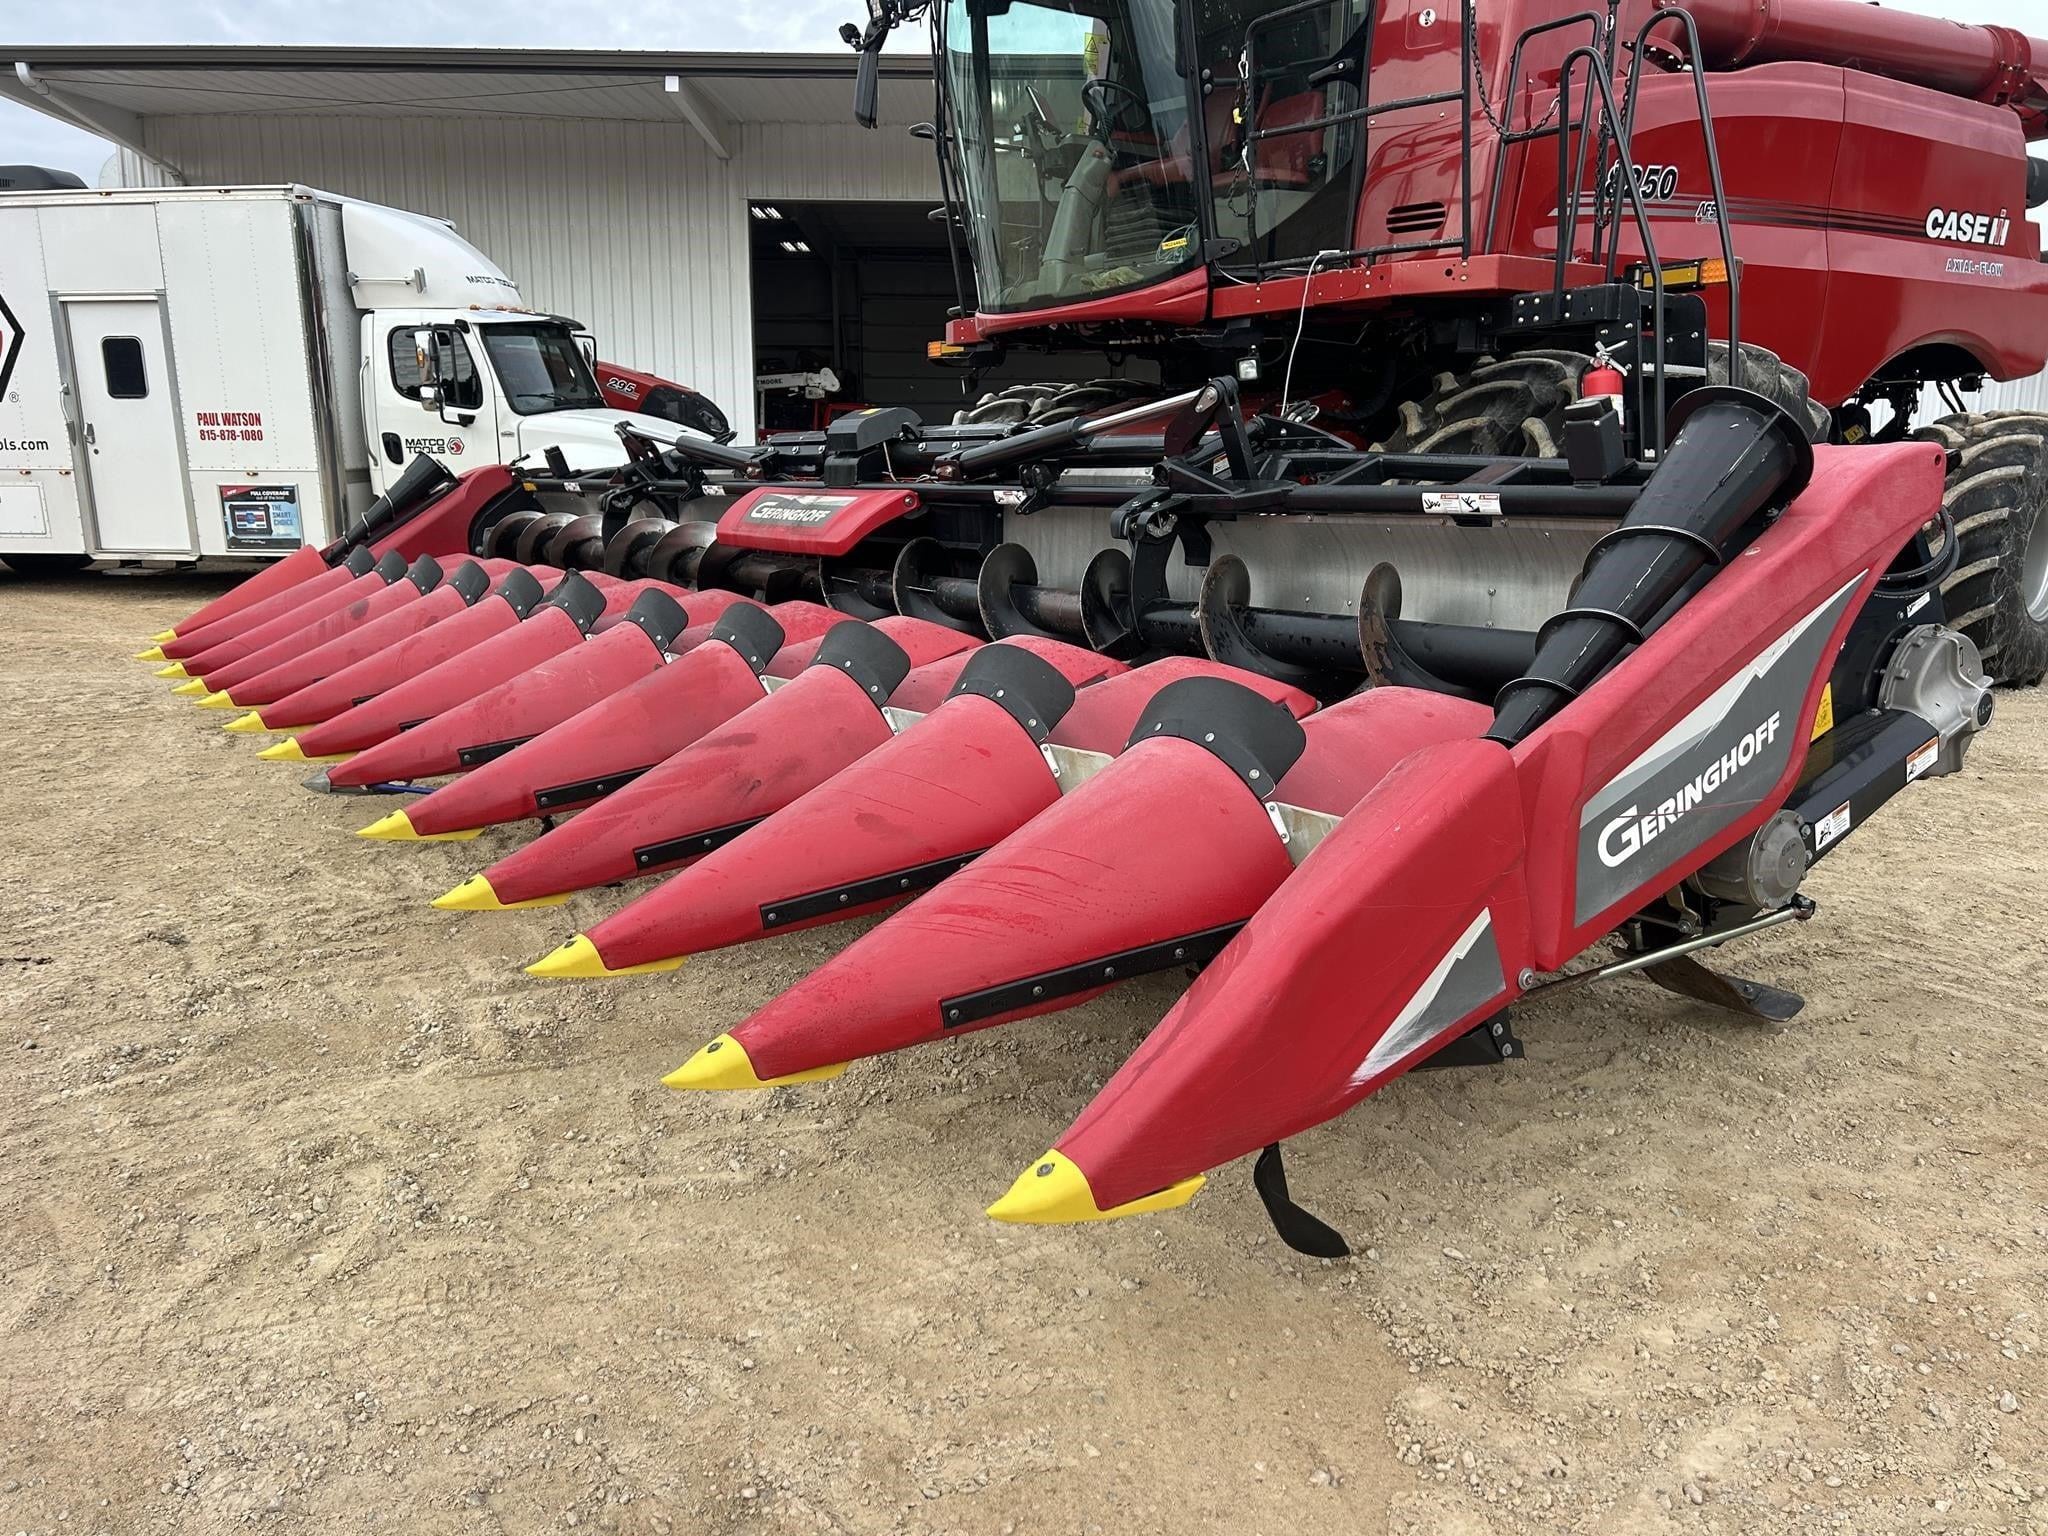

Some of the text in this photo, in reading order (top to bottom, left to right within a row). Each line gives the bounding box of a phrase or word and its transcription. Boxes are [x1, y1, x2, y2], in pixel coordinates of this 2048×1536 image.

[1925, 208, 1990, 244] CASE
[1945, 258, 2004, 277] AXIAL-FLOW
[465, 275, 496, 284] MATCO
[606, 376, 637, 393] 295
[196, 412, 262, 426] PAUL WATSON
[199, 429, 264, 441] 815-878-1080
[405, 438, 445, 447] MATCO
[406, 446, 446, 454] TOOLS
[750, 501, 832, 522] GERINGHOFF
[1598, 711, 1780, 868] GERINGHOFF
